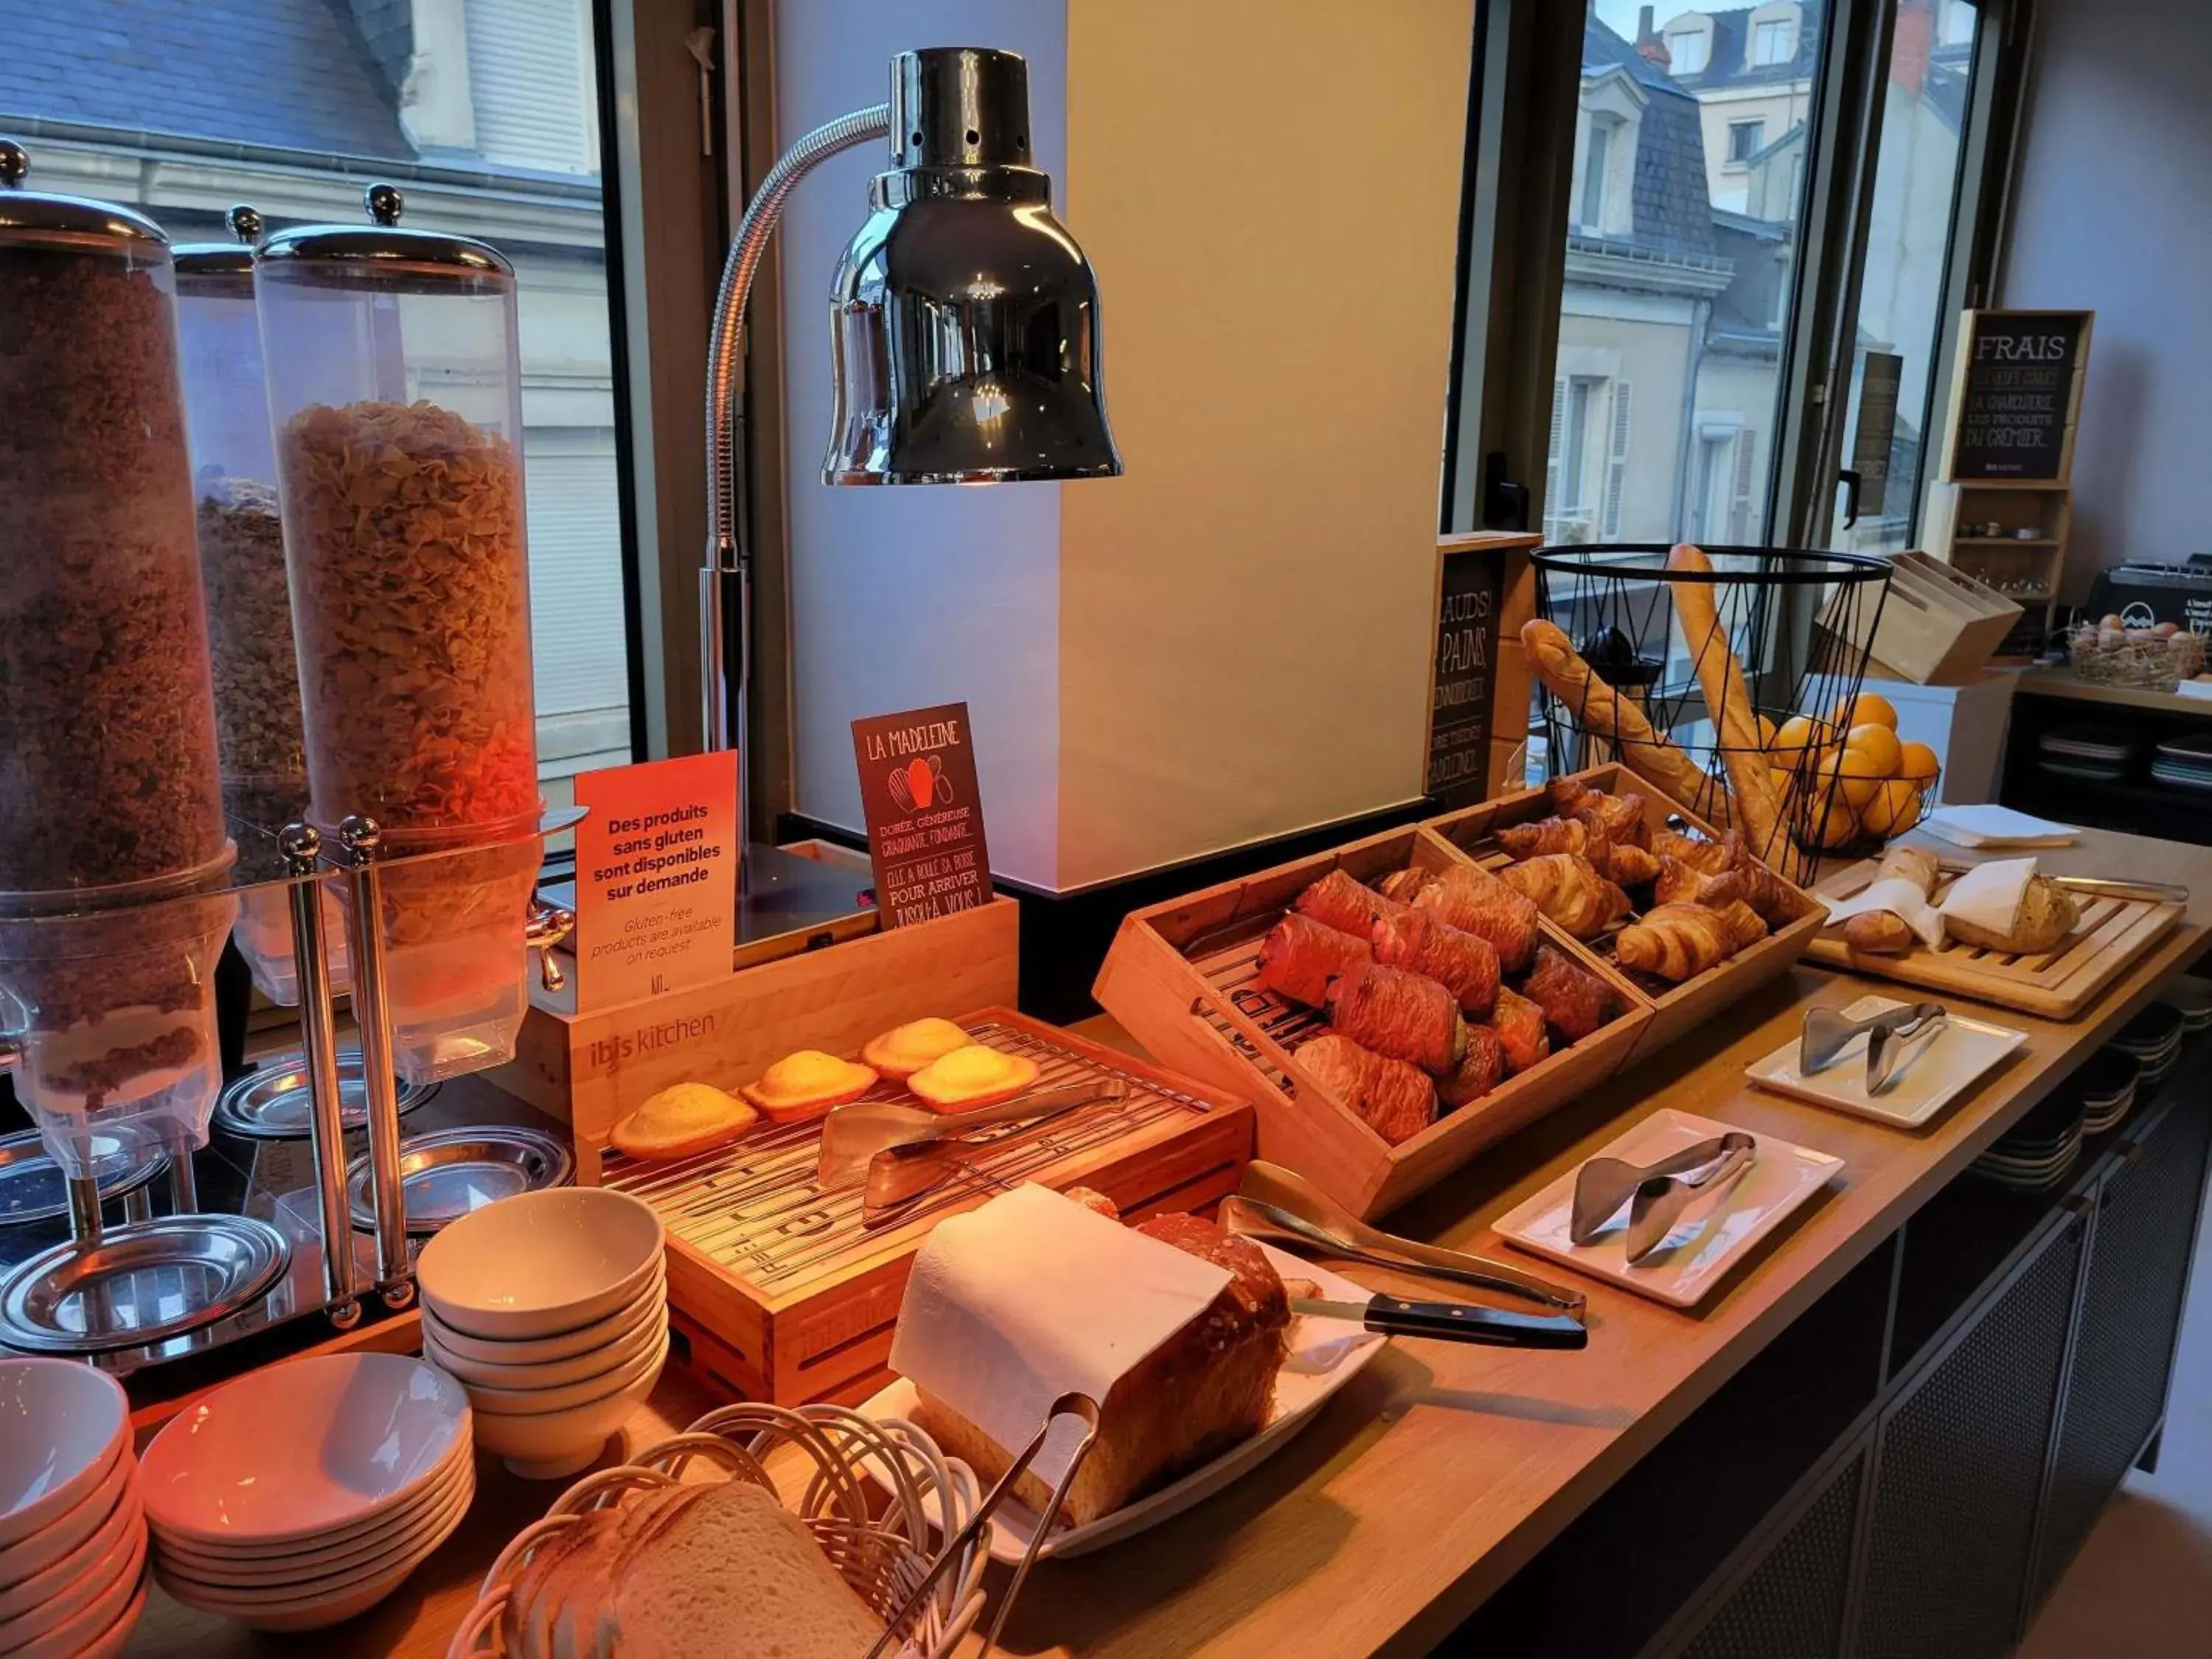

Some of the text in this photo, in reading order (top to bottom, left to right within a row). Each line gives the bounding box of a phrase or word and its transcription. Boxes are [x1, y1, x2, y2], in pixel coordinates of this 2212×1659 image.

[1975, 335, 2067, 361] FRAIS
[1992, 414, 2053, 425] PRODUITS
[1439, 589, 1492, 624] AUDS!
[1442, 626, 1486, 674] PAINS
[866, 720, 961, 762] LA MADELEINE
[608, 804, 709, 835] Des produits
[613, 827, 703, 856] sans gluten
[594, 844, 721, 883] sont disponibles
[607, 866, 709, 901] sur demande
[889, 869, 979, 906] POUR ARRIVER
[624, 906, 694, 933] Gluten-free
[590, 915, 723, 961] products are available
[626, 938, 692, 965] on request
[590, 1014, 715, 1068] ibis kitchen
